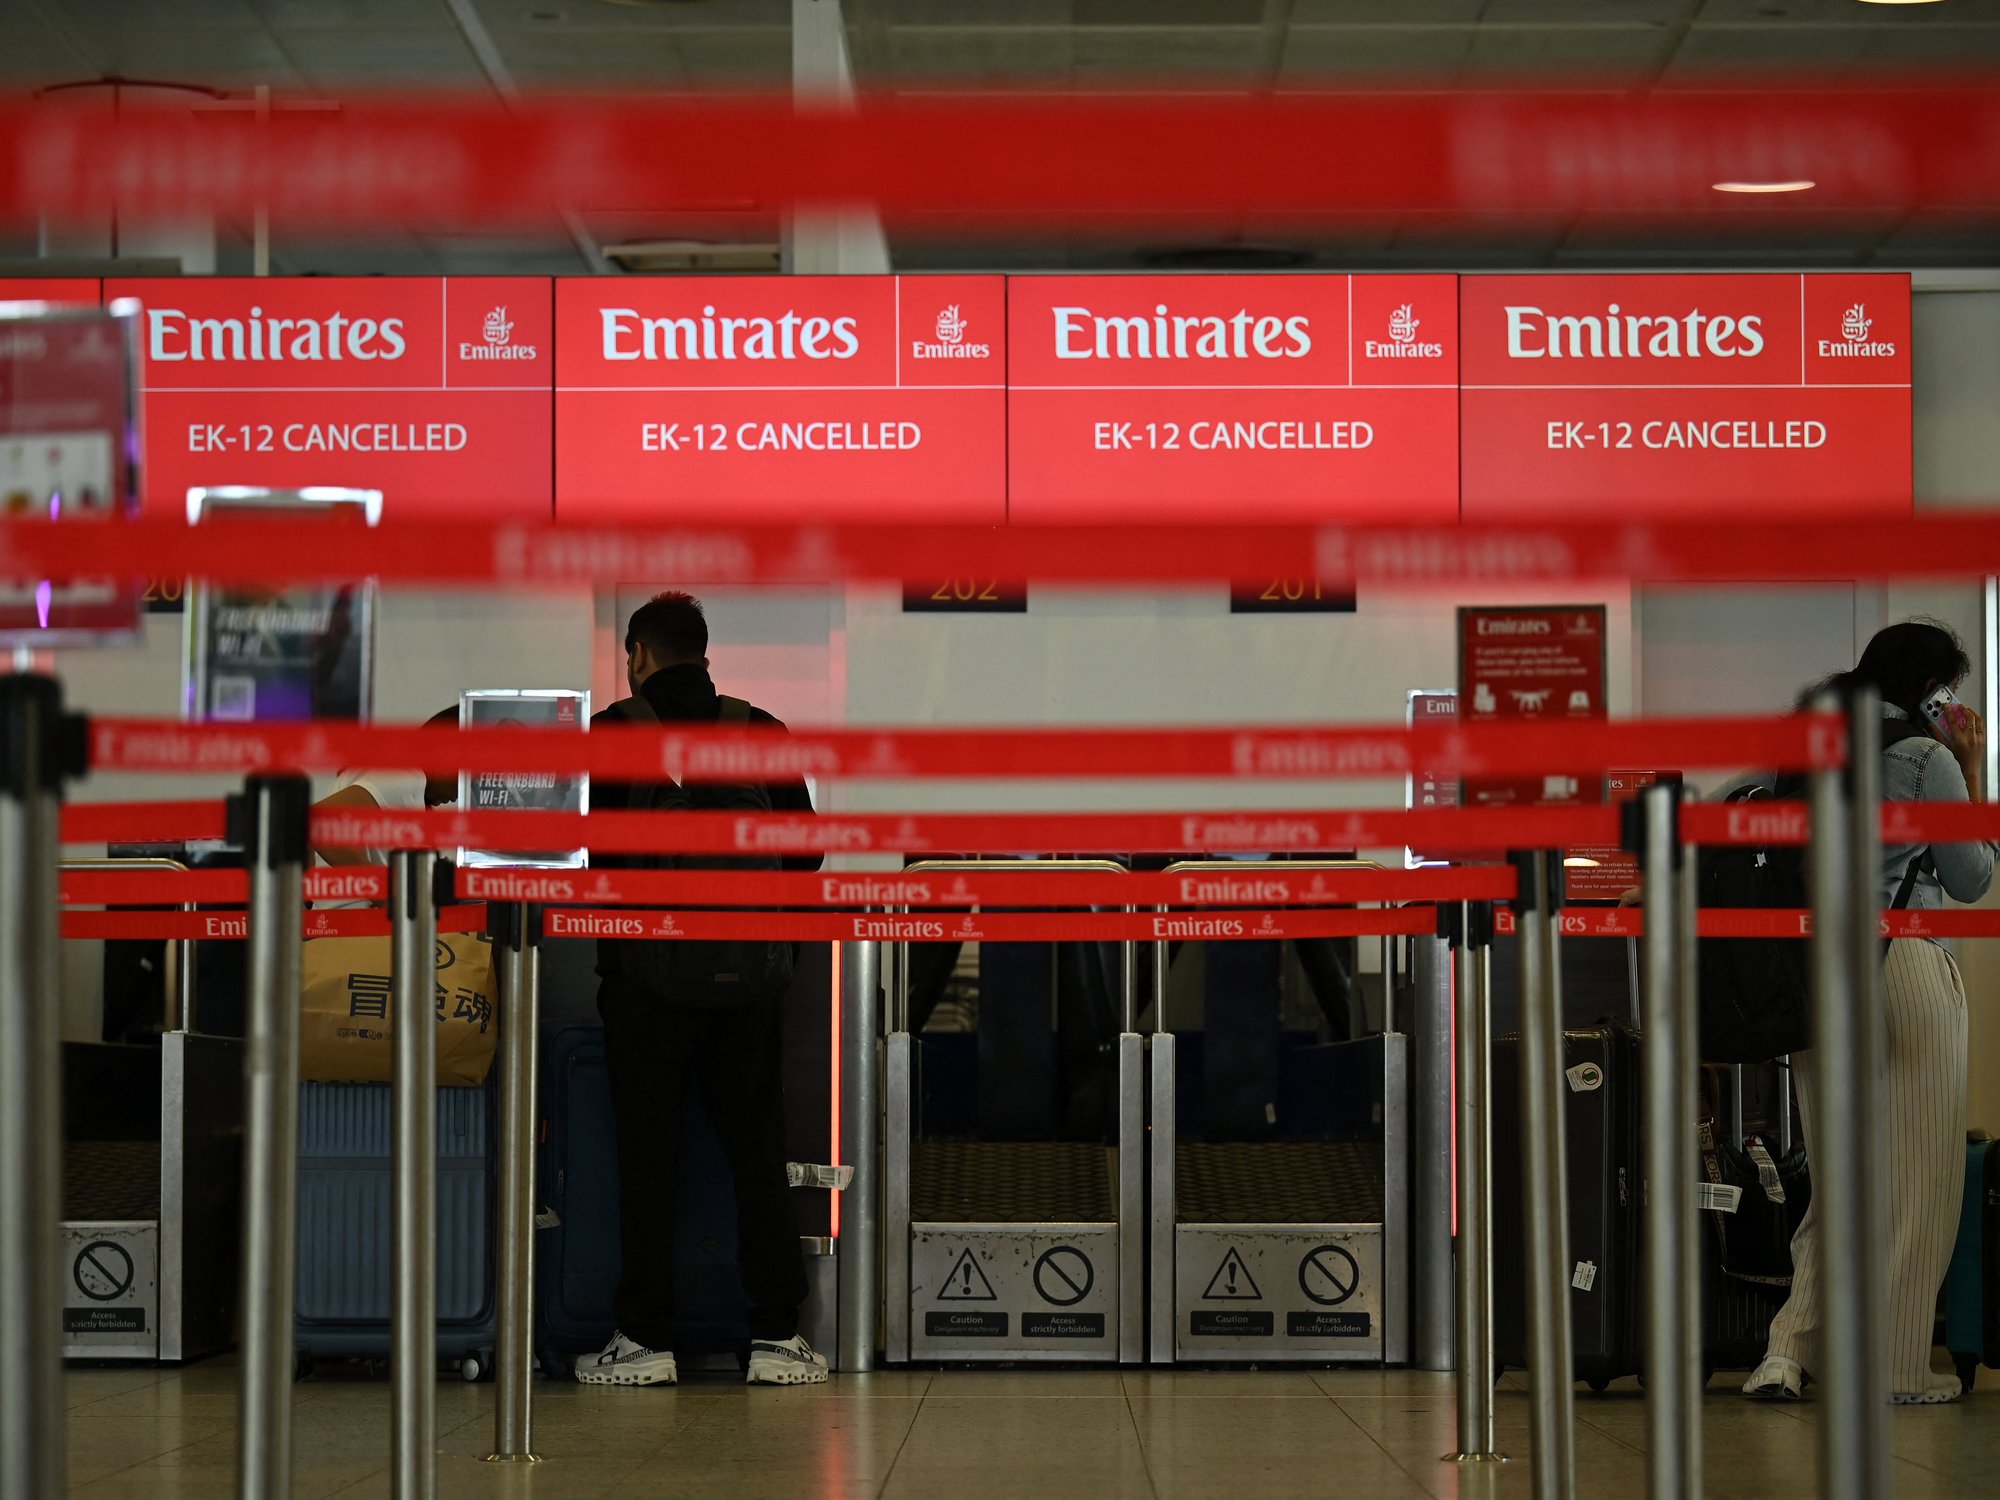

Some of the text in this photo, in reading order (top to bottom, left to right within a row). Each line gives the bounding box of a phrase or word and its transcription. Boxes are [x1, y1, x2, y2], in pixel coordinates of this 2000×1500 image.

[148, 304, 406, 361] Emirates
[600, 303, 859, 361] Emirates
[1053, 303, 1312, 360] Emirates
[1505, 301, 1764, 359] Emirates
[460, 336, 537, 360] Emirates
[913, 335, 990, 359] Emirates
[1366, 335, 1443, 358] Emirates
[1819, 334, 1896, 357] Emirates
[188, 423, 468, 452] EK-12 CANCELLED
[642, 421, 921, 451] EK-12 CANCELLED
[1094, 421, 1374, 450] EK-12 CANCELLED
[1548, 420, 1827, 449] EK-12 CANCELLED
[479, 772, 556, 788] FREE ONBOARD
[479, 790, 509, 805] WI-FI
[311, 815, 424, 844] mirates
[734, 817, 872, 848] Emirates
[1182, 817, 1319, 847] Emirates
[304, 873, 379, 898] irates
[466, 873, 574, 899] Emirates
[823, 878, 931, 902] Emirates
[1181, 878, 1290, 901] Emirates
[307, 927, 338, 936] Emirates
[552, 913, 644, 935] Emirates
[652, 926, 685, 936] Emirates
[853, 918, 944, 938] Emirates
[952, 928, 984, 938] Emirates
[1153, 917, 1243, 937] Emirates
[91, 1311, 116, 1320] Access
[98, 1320, 137, 1329] forbidden
[950, 1315, 983, 1325] Caution
[1051, 1316, 1076, 1325] Access
[1215, 1315, 1249, 1324] Caution
[1316, 1316, 1341, 1324] Access
[1030, 1325, 1096, 1334] strictly forbidden
